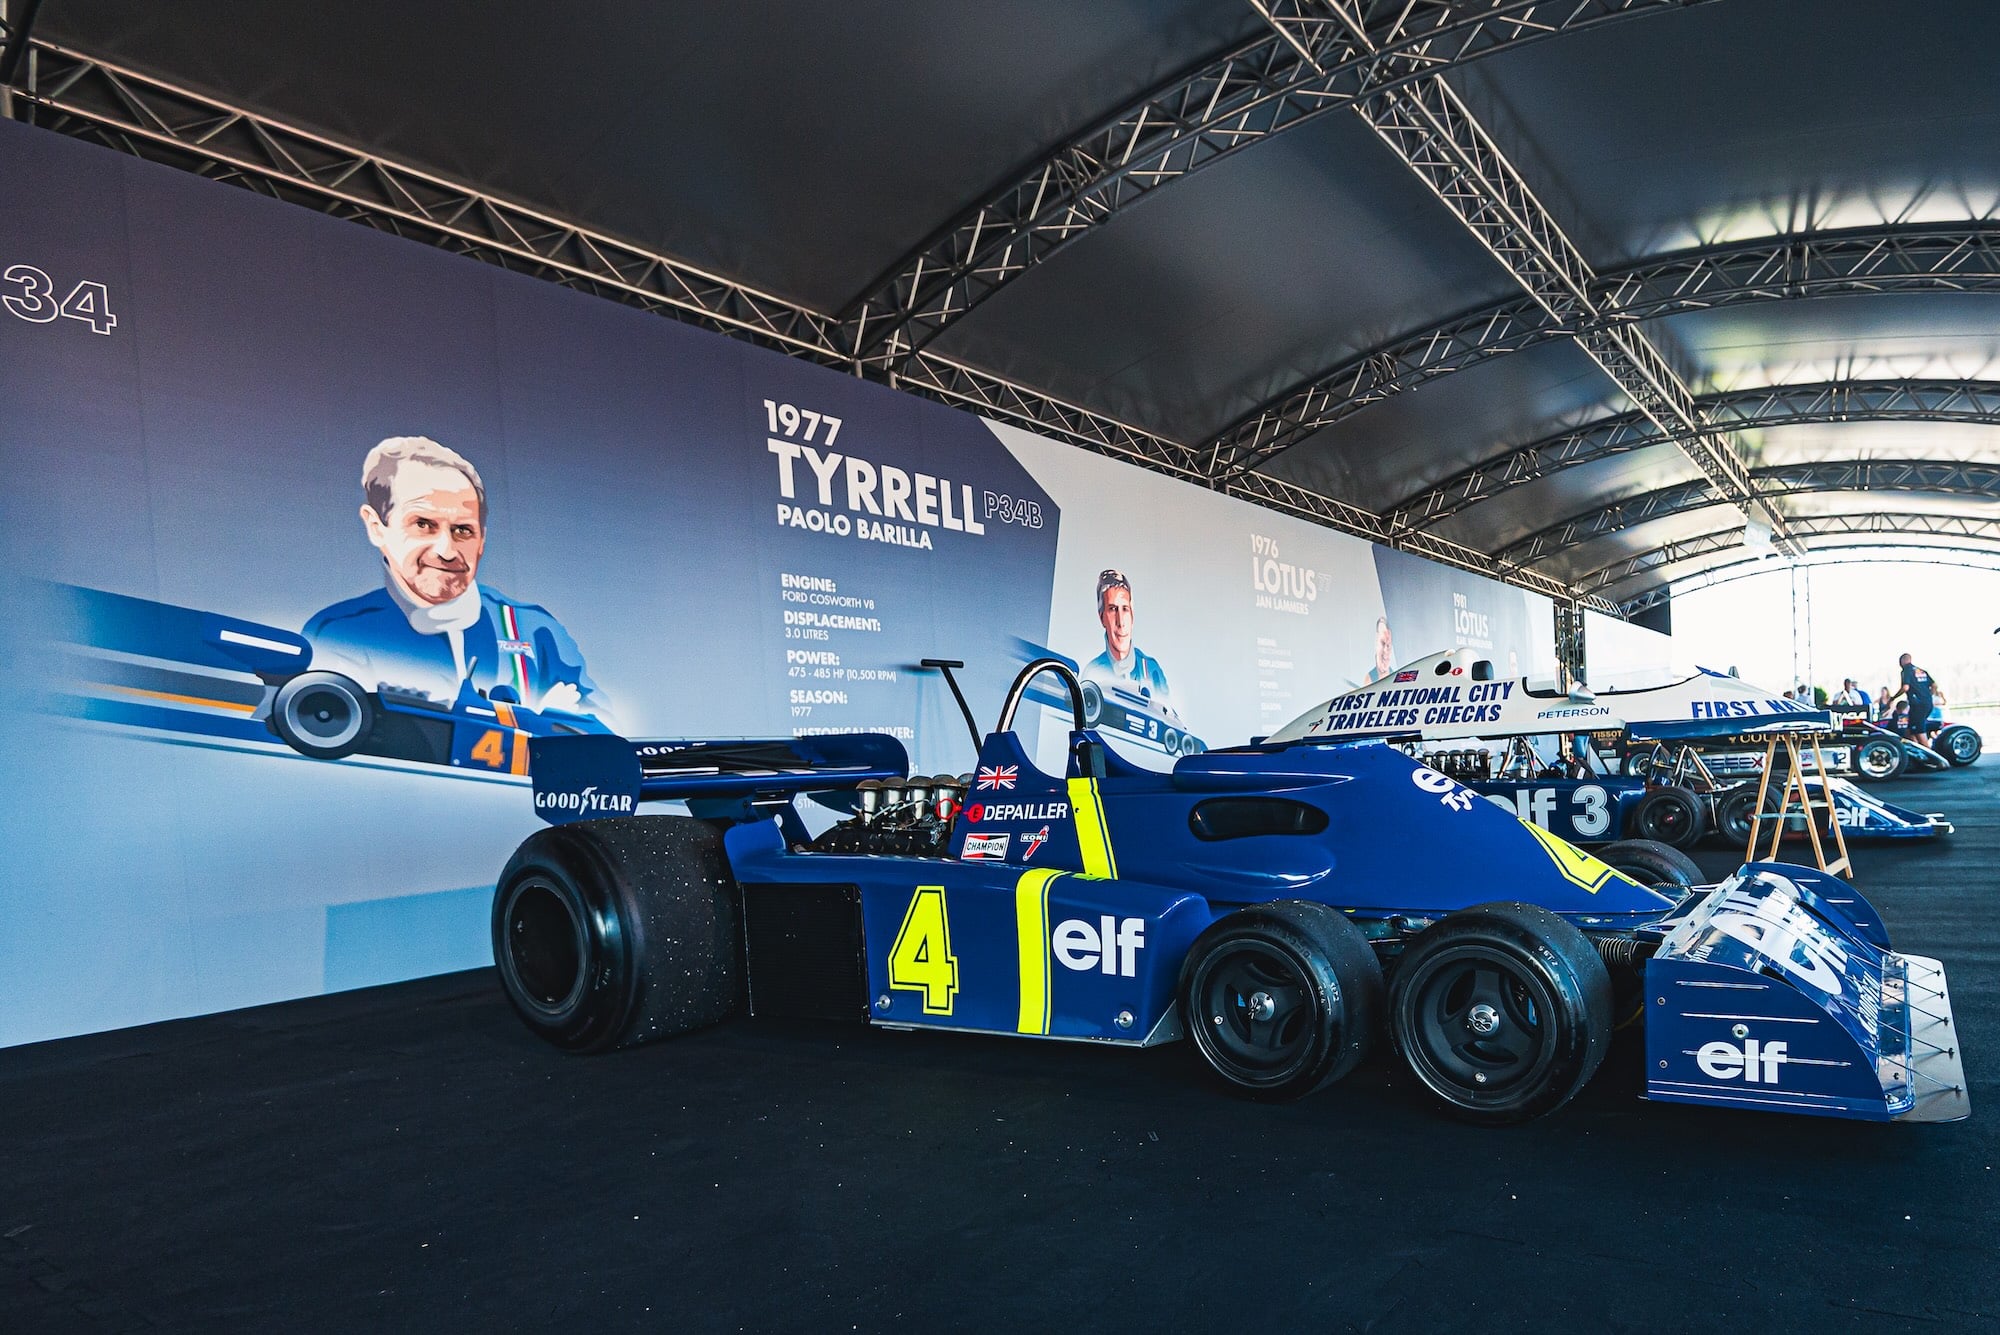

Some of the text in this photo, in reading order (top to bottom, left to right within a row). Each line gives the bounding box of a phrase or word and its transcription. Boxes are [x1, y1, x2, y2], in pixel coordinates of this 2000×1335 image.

[2, 264, 117, 335] 34
[763, 399, 842, 447] 1977
[767, 437, 985, 535] TYRRELL
[983, 490, 1043, 529] P34B
[777, 503, 933, 551] PAOLO BARILLA
[1250, 533, 1279, 559] 1976
[781, 573, 836, 593] ENGINE:
[1253, 556, 1317, 601] LOTUS
[782, 590, 875, 610] FORD COSWORTH V8
[1255, 594, 1272, 609] JAN
[783, 610, 881, 632] DISPLACEMENT:
[1454, 608, 1489, 638] LOTUS
[785, 627, 829, 641] 3.0 LITRES
[786, 649, 840, 666] POWER:
[788, 666, 806, 678] 475
[813, 667, 831, 679] 485
[833, 668, 844, 679] HP
[847, 669, 876, 682] (10,500
[878, 670, 897, 684] RPM)
[790, 689, 848, 704] SEASON:
[1328, 681, 1515, 713] FIRST NATIONAL CITY
[791, 706, 812, 717] 1977
[1326, 704, 1502, 732] TRAVELERS CHECKS
[1537, 706, 1610, 720] PETERSON
[1691, 699, 1761, 719] FIRST
[1148, 719, 1158, 740] 3
[1592, 730, 1623, 738] TISSOT
[471, 729, 505, 768] 4
[535, 790, 633, 813] GOODYEAR
[983, 802, 1069, 821] DEPAILLER
[1571, 784, 1611, 837] 3
[1834, 807, 1870, 827] elf
[966, 839, 1005, 851] CHAMPION
[1022, 833, 1048, 842] KONI
[887, 885, 960, 1016] 4
[1052, 915, 1145, 978] elf
[1696, 1038, 1788, 1084] elf
